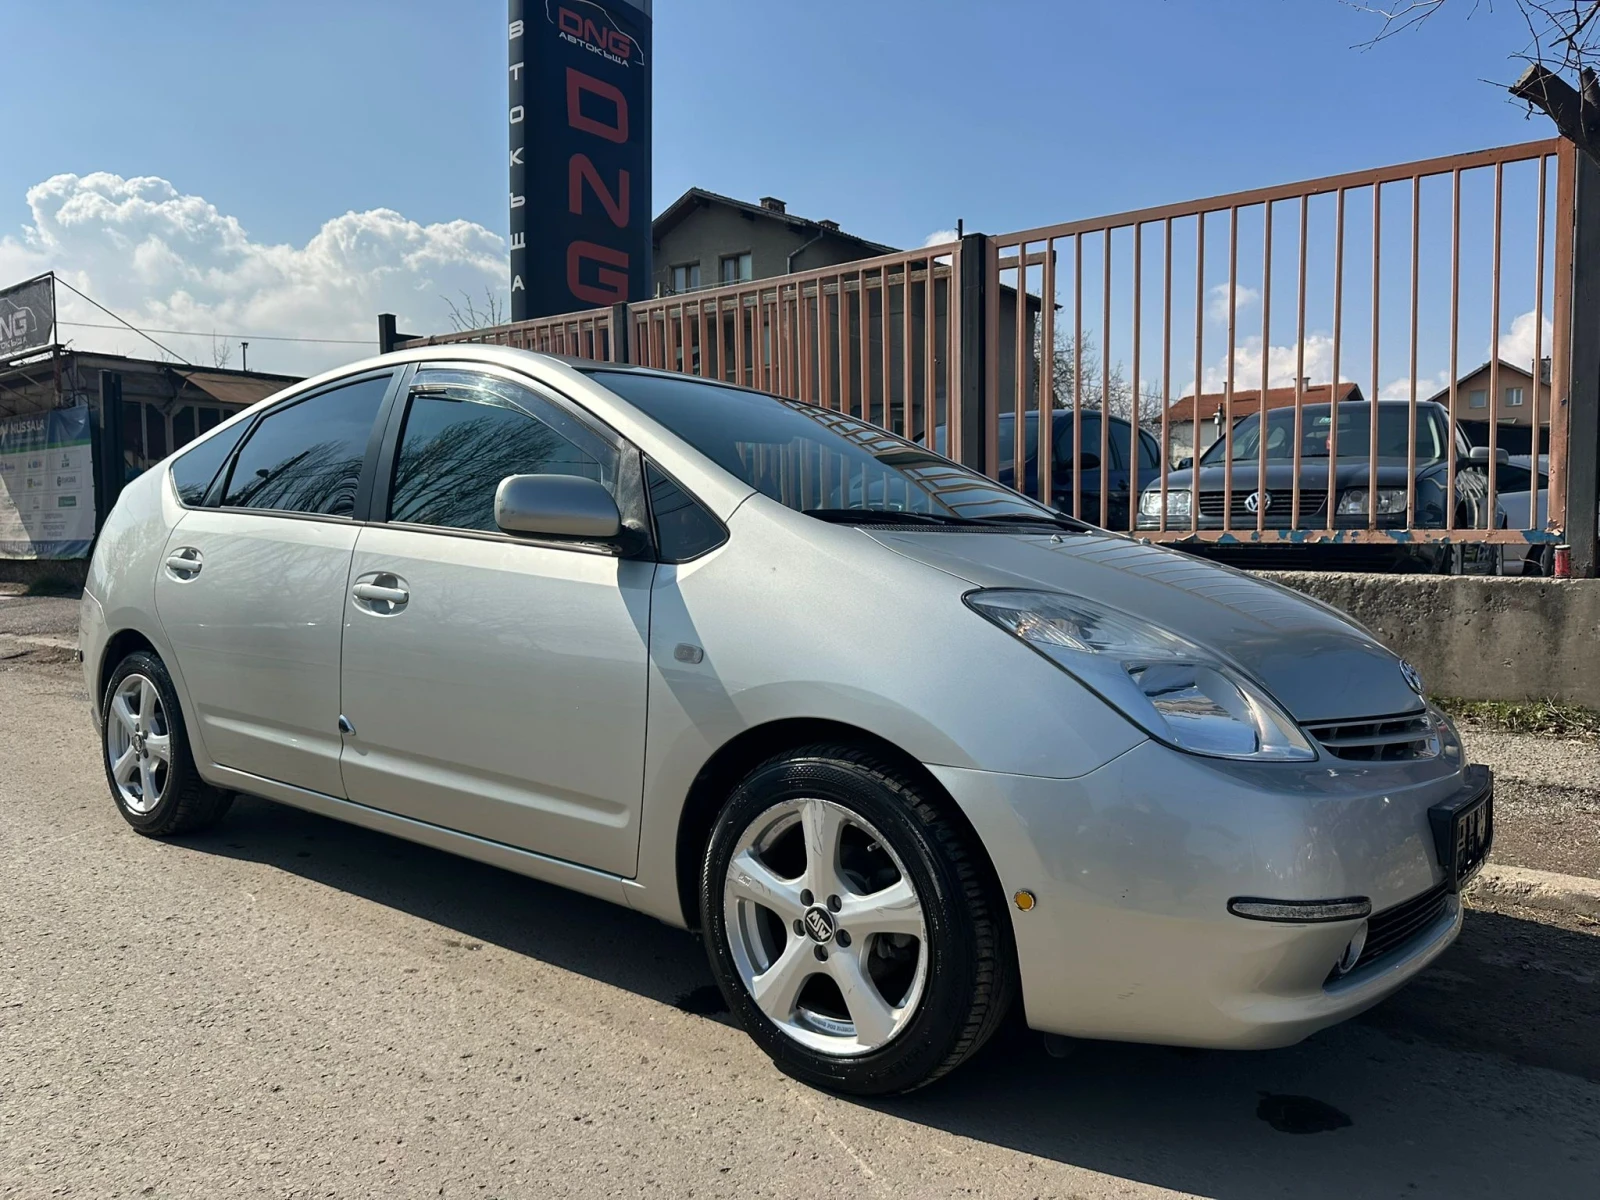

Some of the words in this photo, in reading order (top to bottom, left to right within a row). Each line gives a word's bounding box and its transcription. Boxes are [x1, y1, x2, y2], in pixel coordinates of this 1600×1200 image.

[558, 6, 631, 58] DNG
[559, 31, 629, 67] АВТОКЪЩА
[566, 67, 630, 305] DNG
[806, 910, 832, 940] MSW
